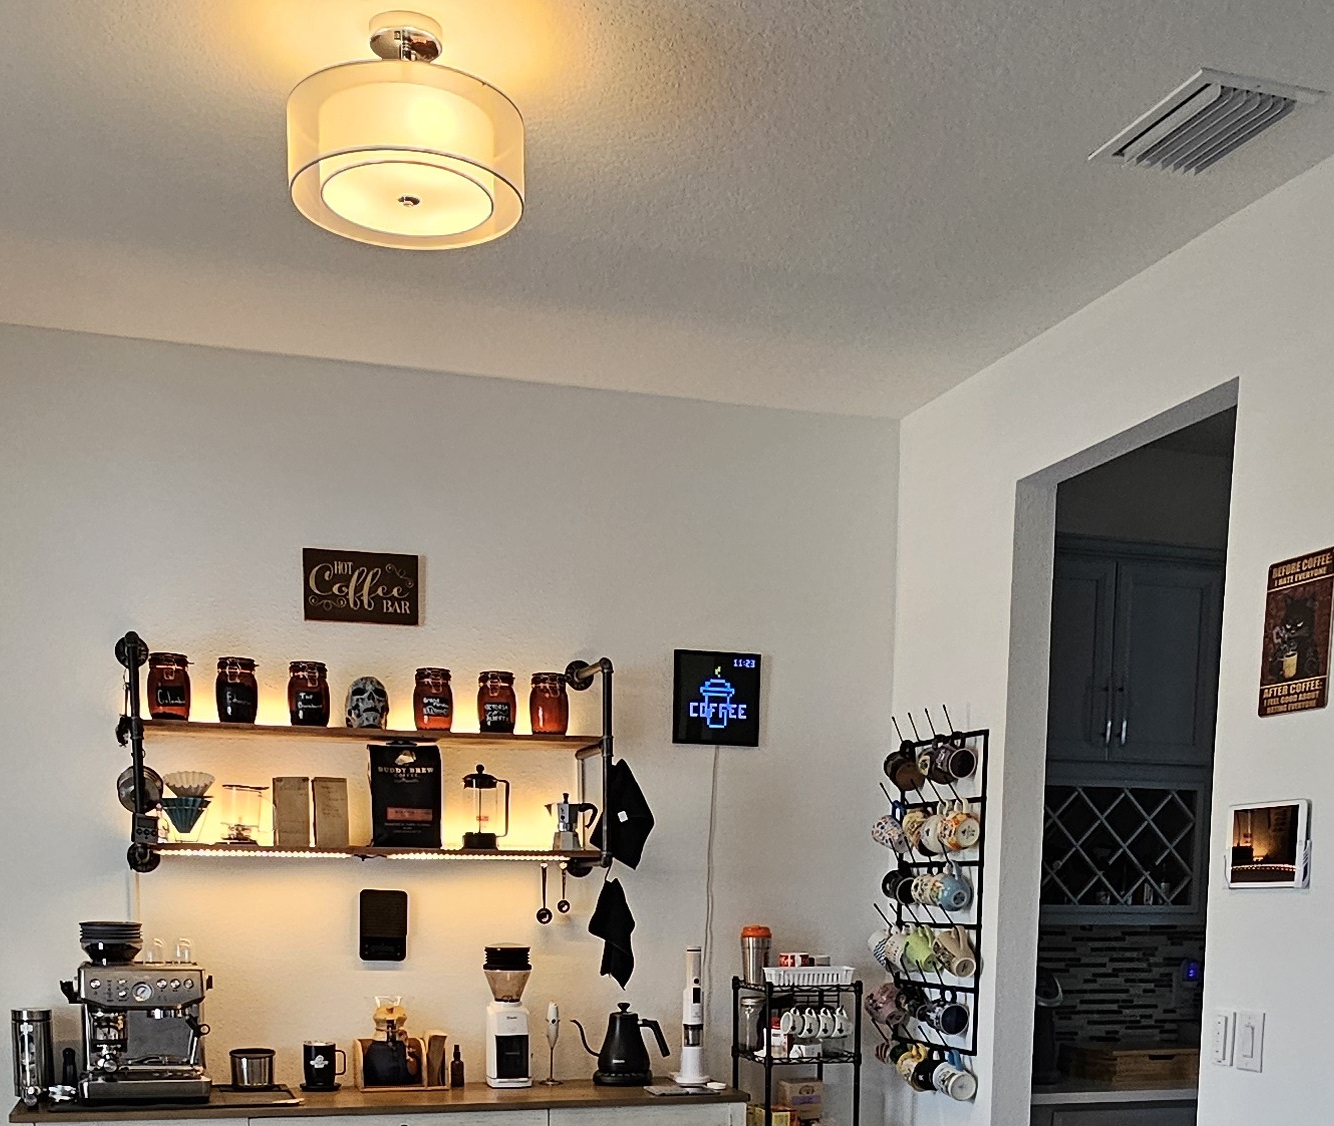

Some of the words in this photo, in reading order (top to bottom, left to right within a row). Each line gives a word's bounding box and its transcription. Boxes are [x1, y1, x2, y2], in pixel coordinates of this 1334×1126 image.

[334, 561, 353, 575] HOT
[1272, 561, 1301, 578] BEFORE
[309, 563, 410, 610] Coffee
[383, 600, 410, 614] BAR
[1263, 686, 1288, 698] AFTER
[689, 702, 747, 719] COFFEE
